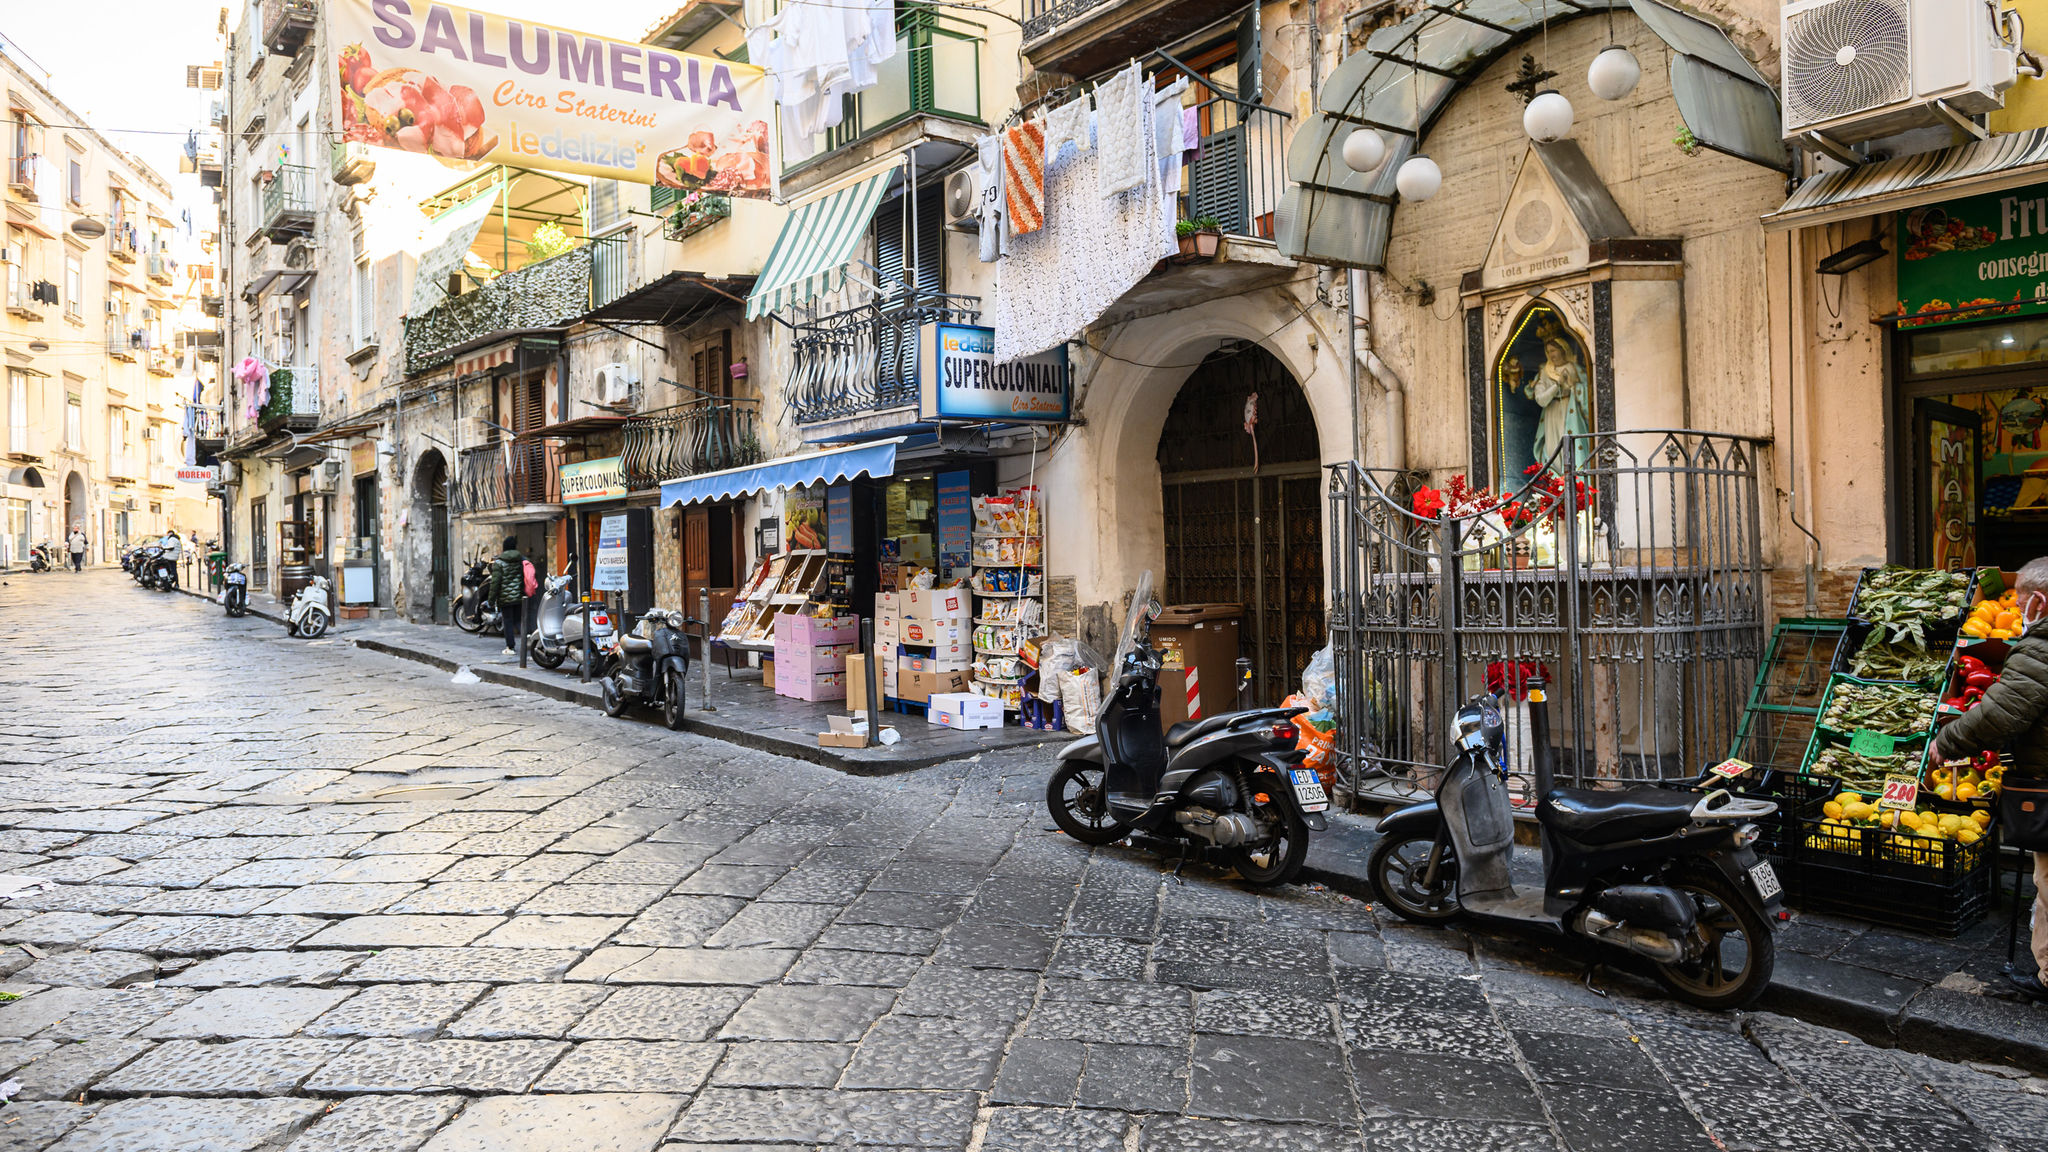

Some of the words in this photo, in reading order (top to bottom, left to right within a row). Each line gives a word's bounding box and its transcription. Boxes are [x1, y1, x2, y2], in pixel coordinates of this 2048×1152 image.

[372, 0, 743, 112] SALUMERIA
[492, 79, 548, 109] Ciro
[555, 90, 657, 129] Staterini
[511, 121, 637, 169] ledelizie
[944, 333, 996, 355] ledeliz
[944, 356, 1063, 394] SUPERCOLONIALI
[177, 470, 212, 479] MORENO
[1298, 786, 1325, 801] 12306
[1884, 782, 1916, 802] 2.00
